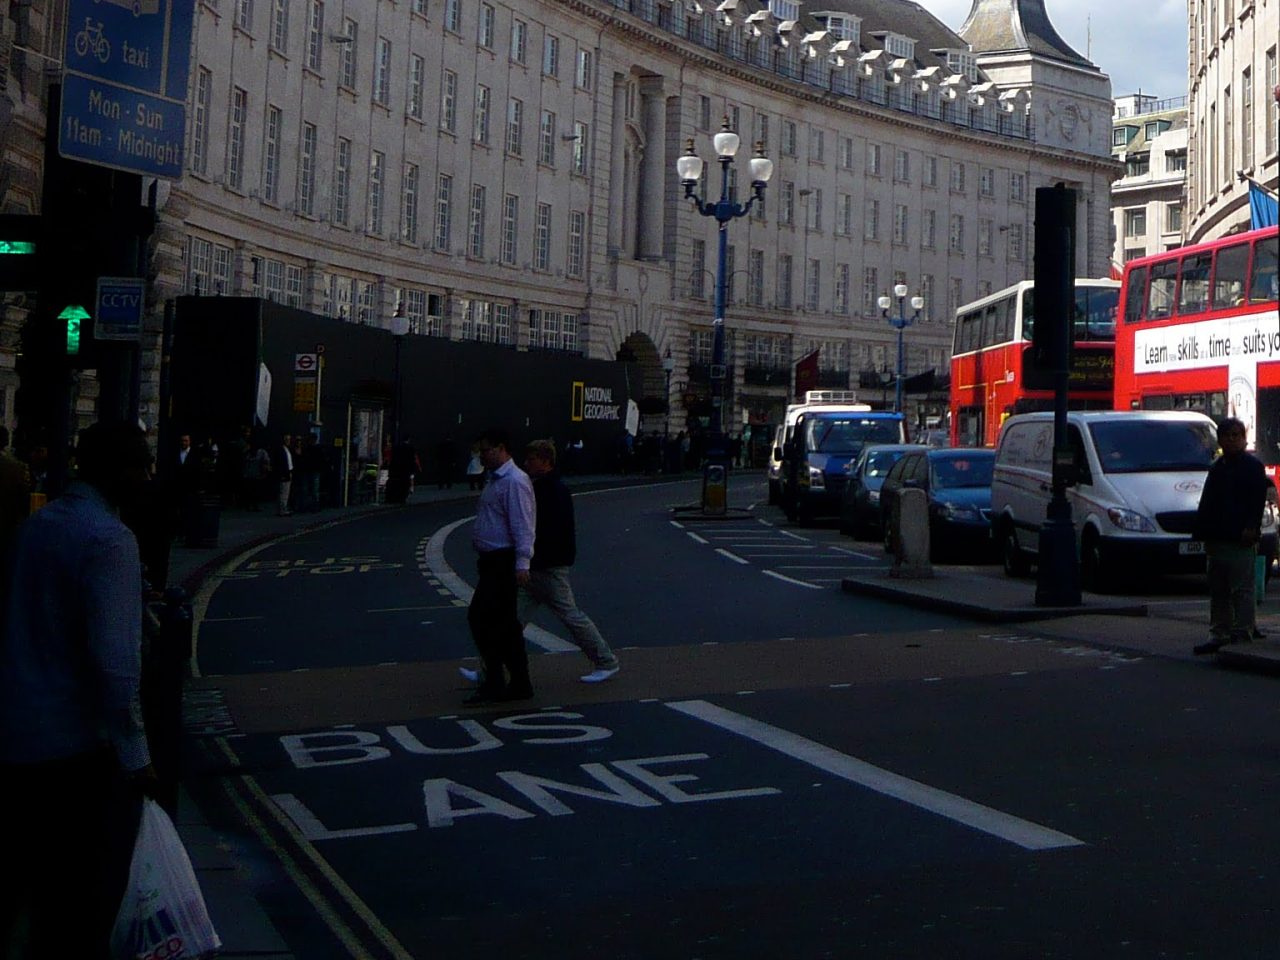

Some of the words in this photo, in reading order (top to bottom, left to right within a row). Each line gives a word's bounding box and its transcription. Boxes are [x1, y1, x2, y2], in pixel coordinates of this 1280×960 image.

[122, 39, 150, 68] taxi
[88, 90, 120, 120] Mon
[135, 103, 163, 131] Sun
[66, 116, 101, 146] 11am
[118, 129, 180, 166] Midnight
[101, 293, 140, 308] CCTV
[1144, 343, 1168, 365] Learn
[1177, 336, 1199, 361] skills
[1209, 333, 1231, 358] time
[1243, 327, 1266, 355] suits
[585, 386, 613, 403] NATIONAL
[584, 403, 621, 421] GEOGRAPHIC
[217, 562, 404, 581] STOP
[279, 711, 614, 770] BUS
[270, 752, 784, 841] LANE
